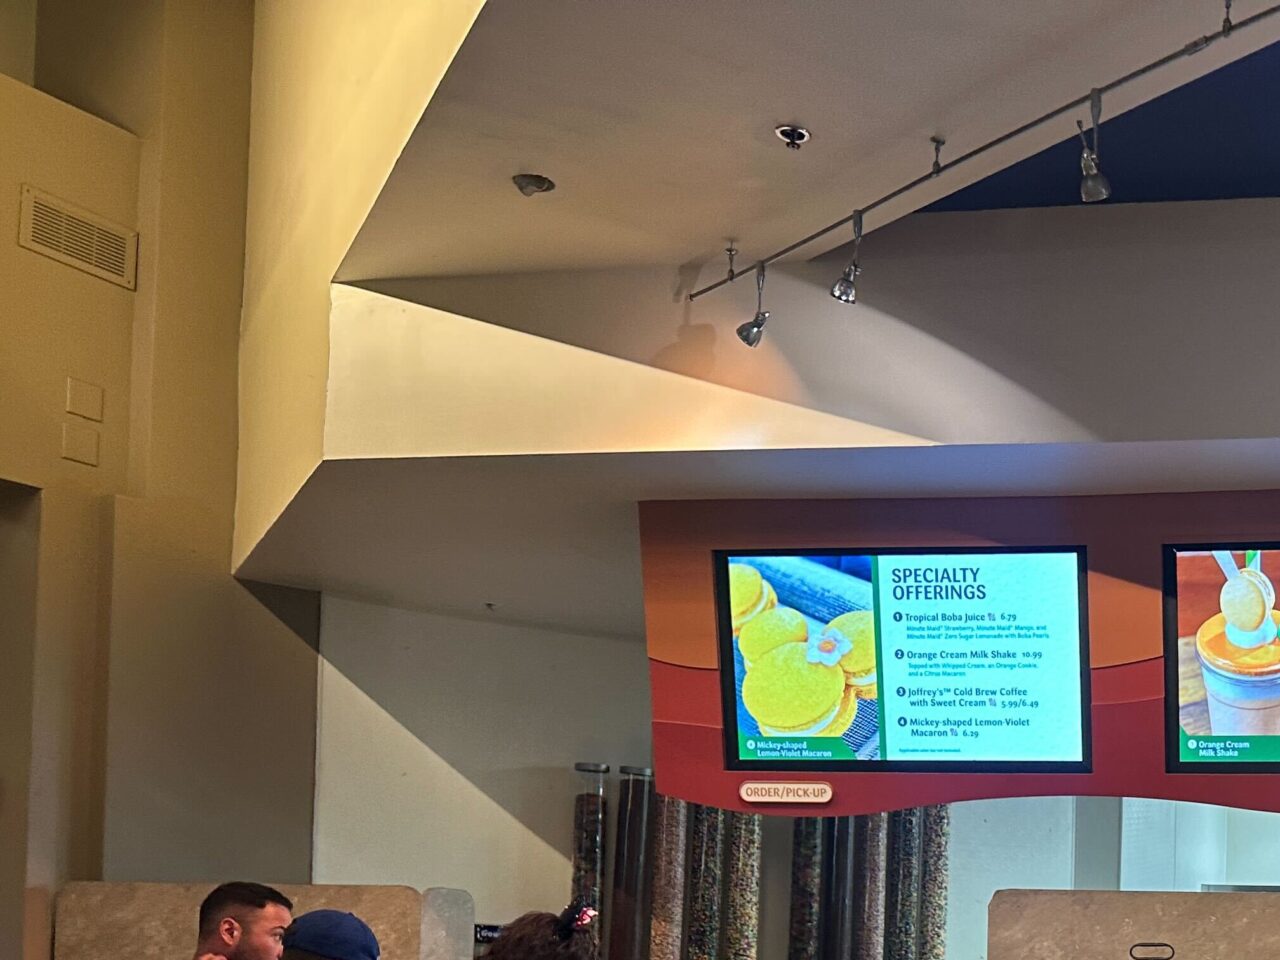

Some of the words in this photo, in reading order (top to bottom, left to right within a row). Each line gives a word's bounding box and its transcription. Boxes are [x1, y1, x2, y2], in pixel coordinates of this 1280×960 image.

[892, 568, 980, 583] SPECIALTY
[893, 584, 987, 600] OFFERINGS
[905, 613, 938, 623] Tropical
[941, 613, 962, 621] Boba
[965, 613, 985, 623] Juice
[1000, 613, 1016, 622] 6.79
[907, 651, 937, 661] Orange
[940, 651, 967, 659] Cream
[970, 650, 988, 659] Milk
[991, 650, 1017, 658] Shake
[1022, 651, 1042, 659] 10.99
[954, 688, 972, 696] Cold
[910, 699, 928, 707] with
[931, 699, 956, 707] Sweet
[959, 699, 986, 707] Cream
[1001, 700, 1039, 708] 5.99/6.49
[910, 718, 973, 728] Mickey-shaped
[975, 718, 1030, 726] Lemon-Violet
[911, 729, 947, 737] Macaron
[963, 729, 978, 737] 6.29
[757, 741, 807, 750] Mickey-shaped
[1199, 741, 1224, 749] Orange
[746, 786, 826, 799] ORDER/PICK-UP
